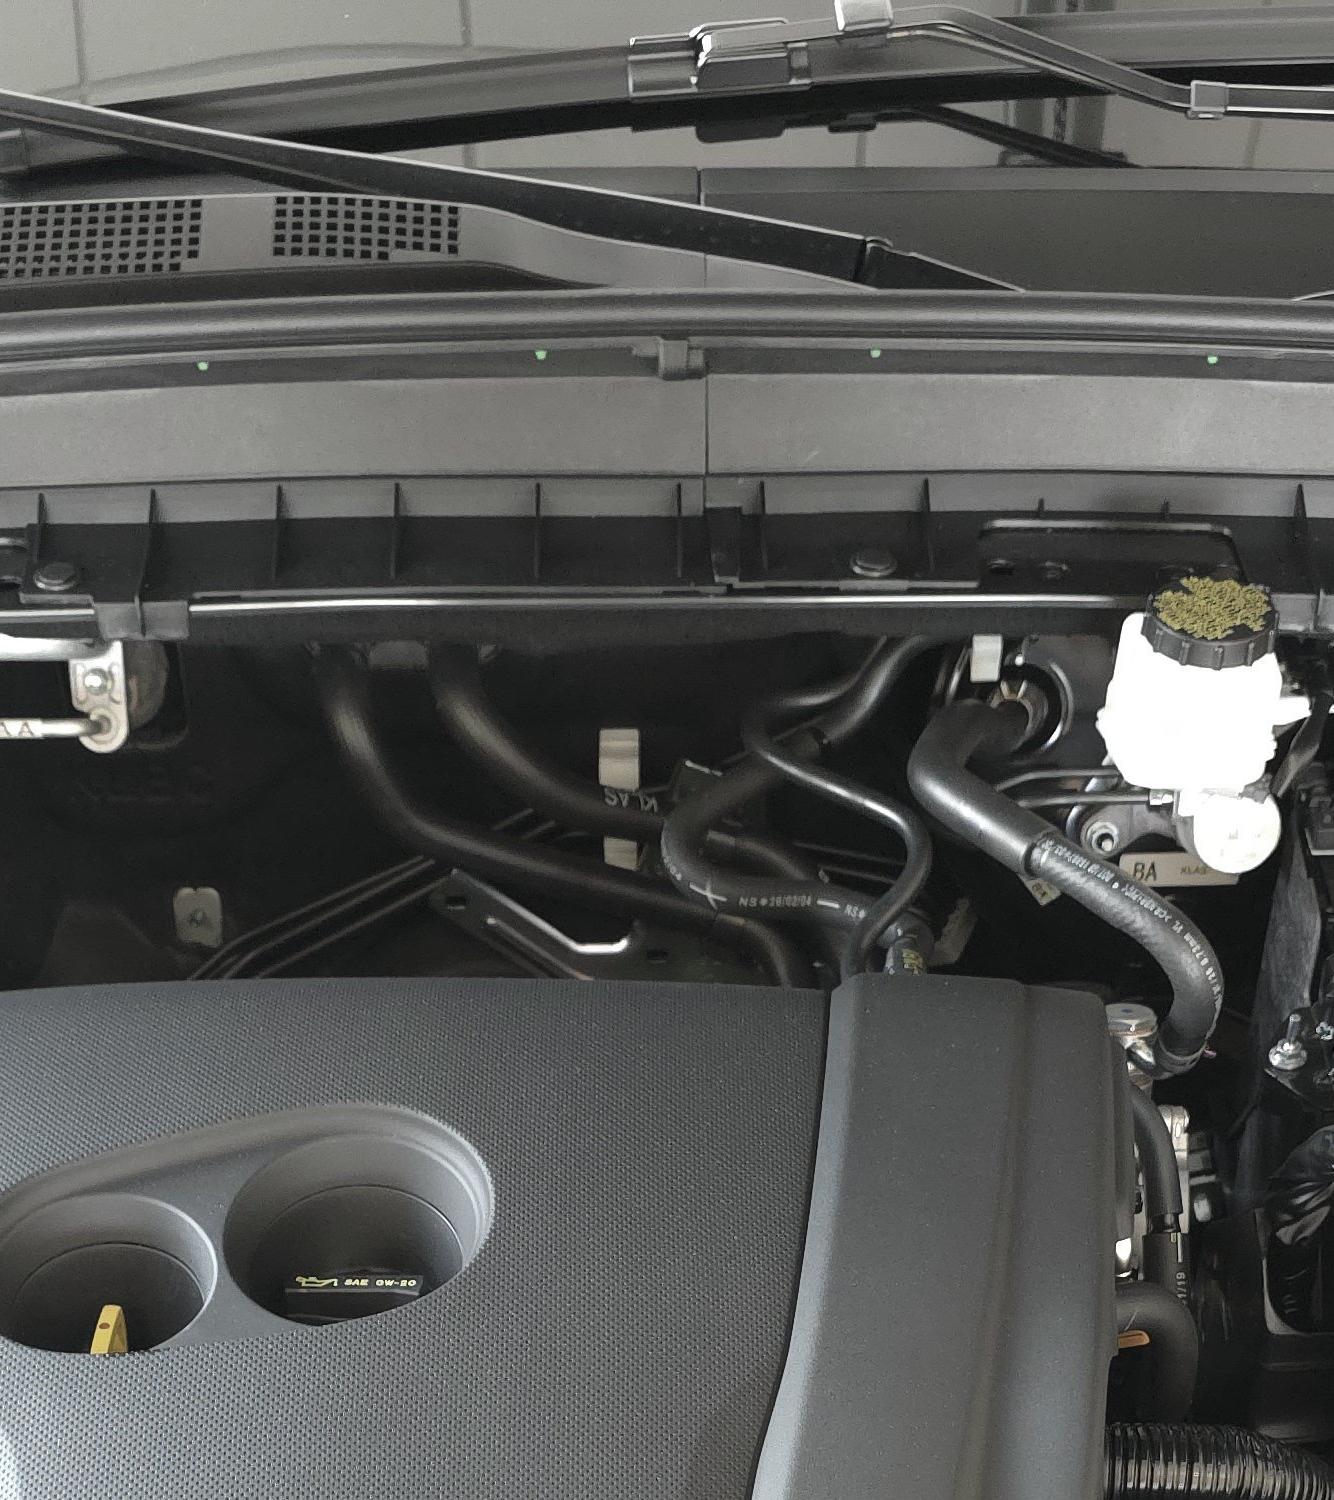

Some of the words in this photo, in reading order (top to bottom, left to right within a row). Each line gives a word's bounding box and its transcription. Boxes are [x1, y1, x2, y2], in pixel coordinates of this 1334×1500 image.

[1133, 861, 1157, 881] BA
[344, 1278, 369, 1287] SAE
[375, 1279, 417, 1288] 0W-20
